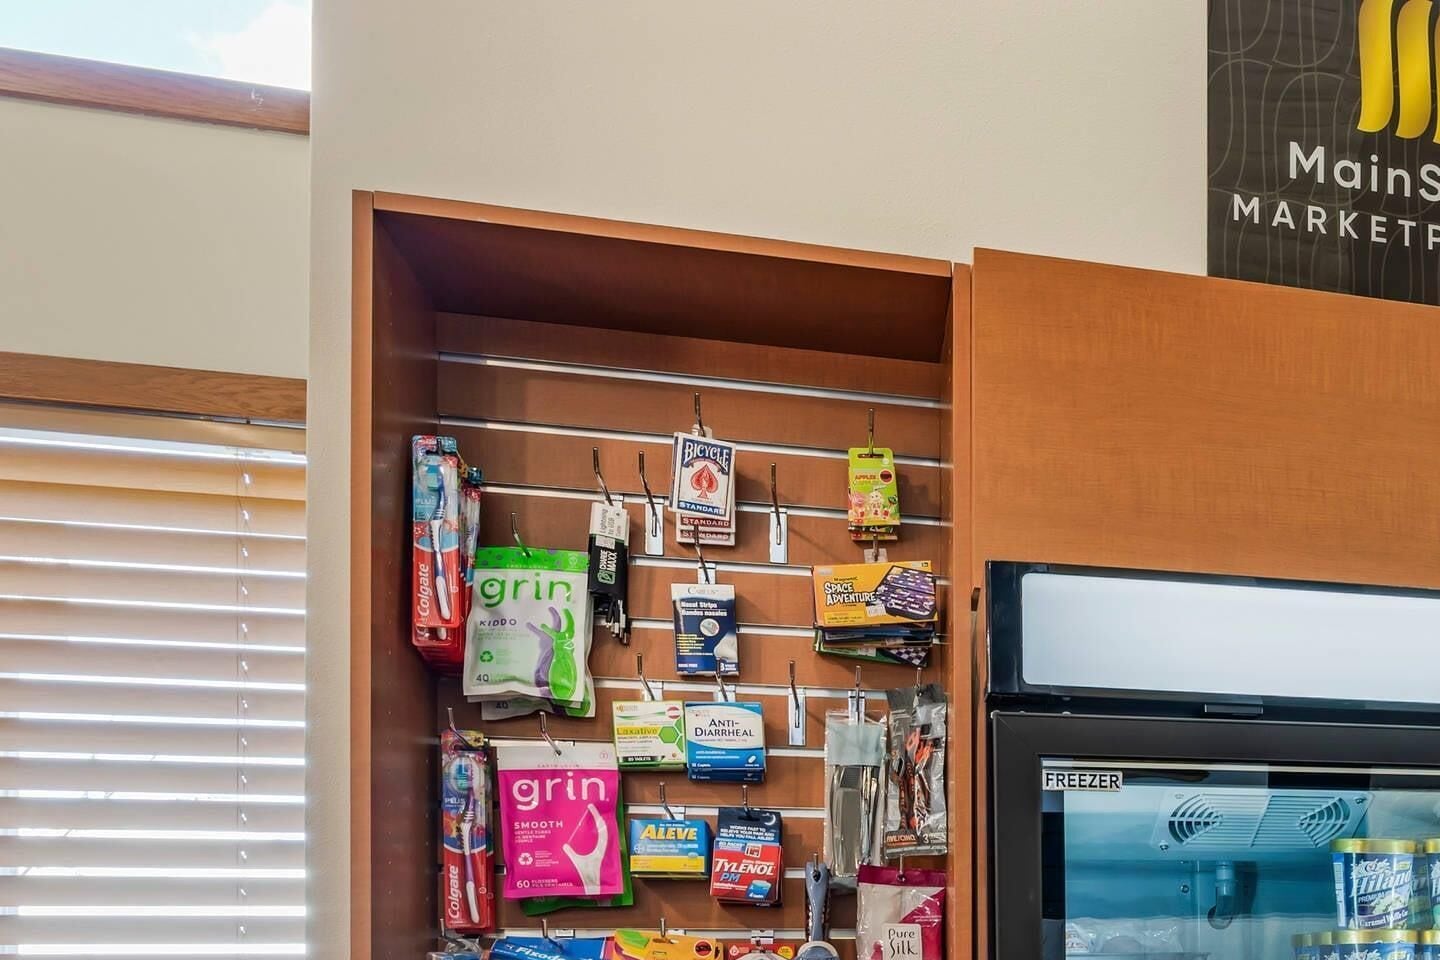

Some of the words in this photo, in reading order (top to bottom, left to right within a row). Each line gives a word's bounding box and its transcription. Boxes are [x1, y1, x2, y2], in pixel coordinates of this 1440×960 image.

[683, 441, 729, 472] BICYCLE
[679, 502, 725, 515] STANDARD
[682, 517, 730, 527] STANDARD
[607, 551, 618, 571] MAXX
[417, 563, 430, 618] Colgate
[480, 572, 573, 608] grin
[824, 582, 854, 595] SPACE
[825, 592, 877, 607] ADVENTURE
[479, 617, 517, 627] KIDDO
[475, 673, 490, 683] 40
[708, 718, 740, 728] ANTI-
[694, 727, 755, 738] DIARRHEAL
[1044, 772, 1121, 789] FREEZER
[512, 771, 608, 811] grin
[513, 820, 564, 830] SMOOTH
[639, 825, 698, 841] ALEVE
[922, 833, 929, 844] 3
[714, 858, 776, 876] TYLENOL
[516, 880, 531, 889] 60
[719, 873, 742, 883] PM
[1350, 866, 1412, 895] Hiland
[447, 864, 461, 920] Colgate
[887, 929, 916, 940] Pure
[888, 938, 918, 959] Silk
